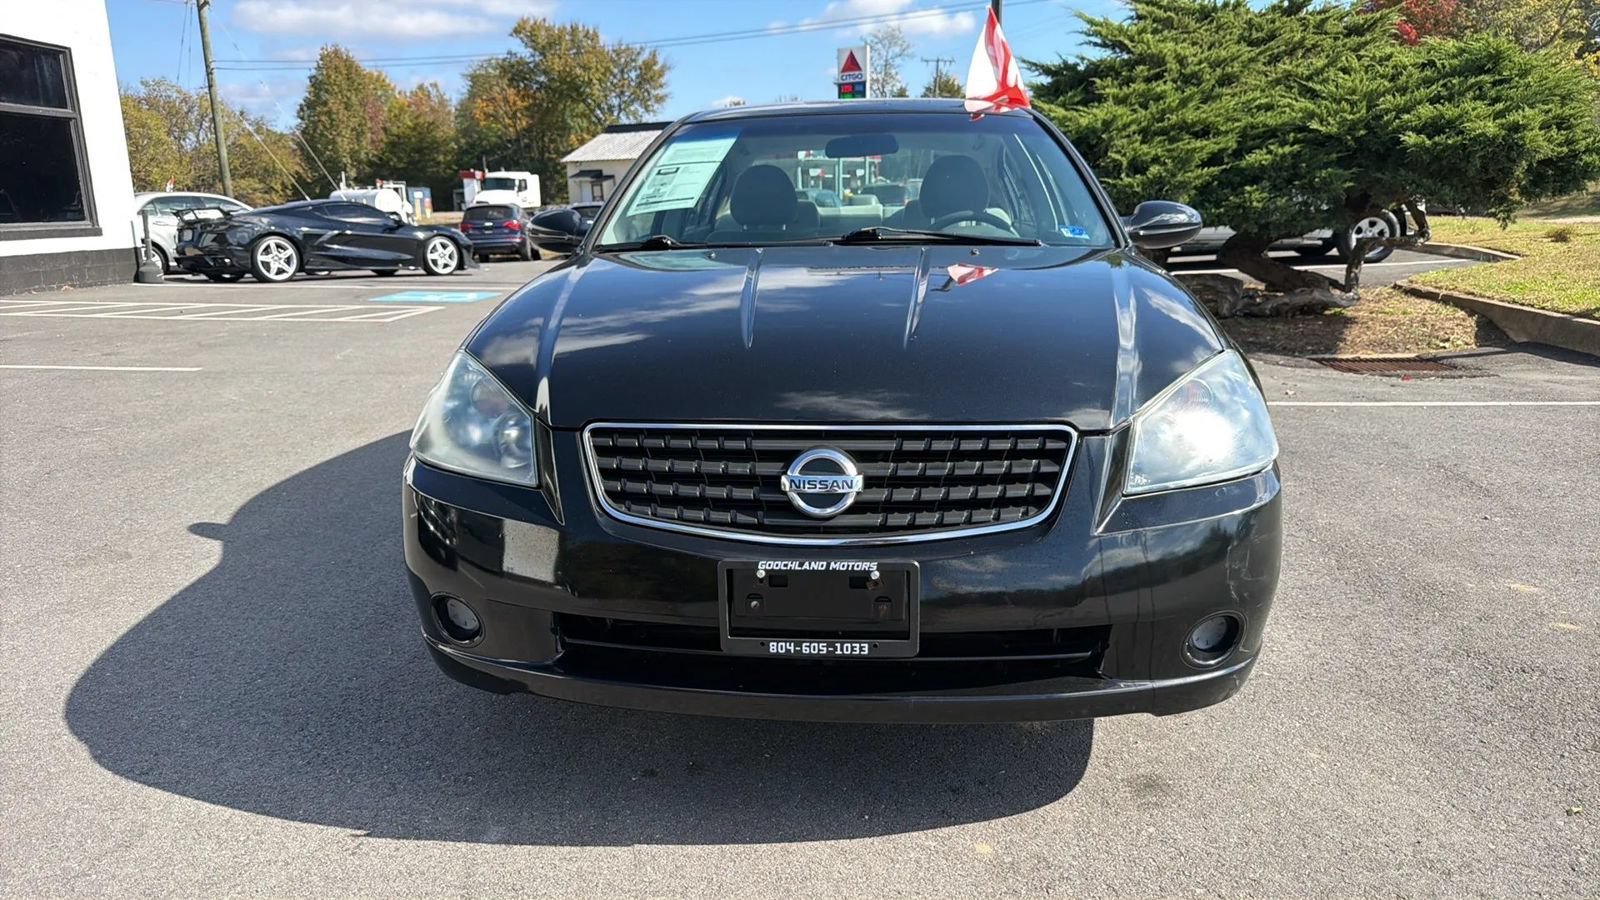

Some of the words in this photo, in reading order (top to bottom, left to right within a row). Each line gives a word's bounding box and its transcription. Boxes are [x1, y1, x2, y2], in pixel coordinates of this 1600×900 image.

[841, 73, 863, 81] CITGO
[789, 479, 854, 490] NISSAN
[758, 561, 826, 571] GOOCHLAND
[830, 561, 877, 571] MOTORS
[769, 642, 869, 655] 804-605-1033
